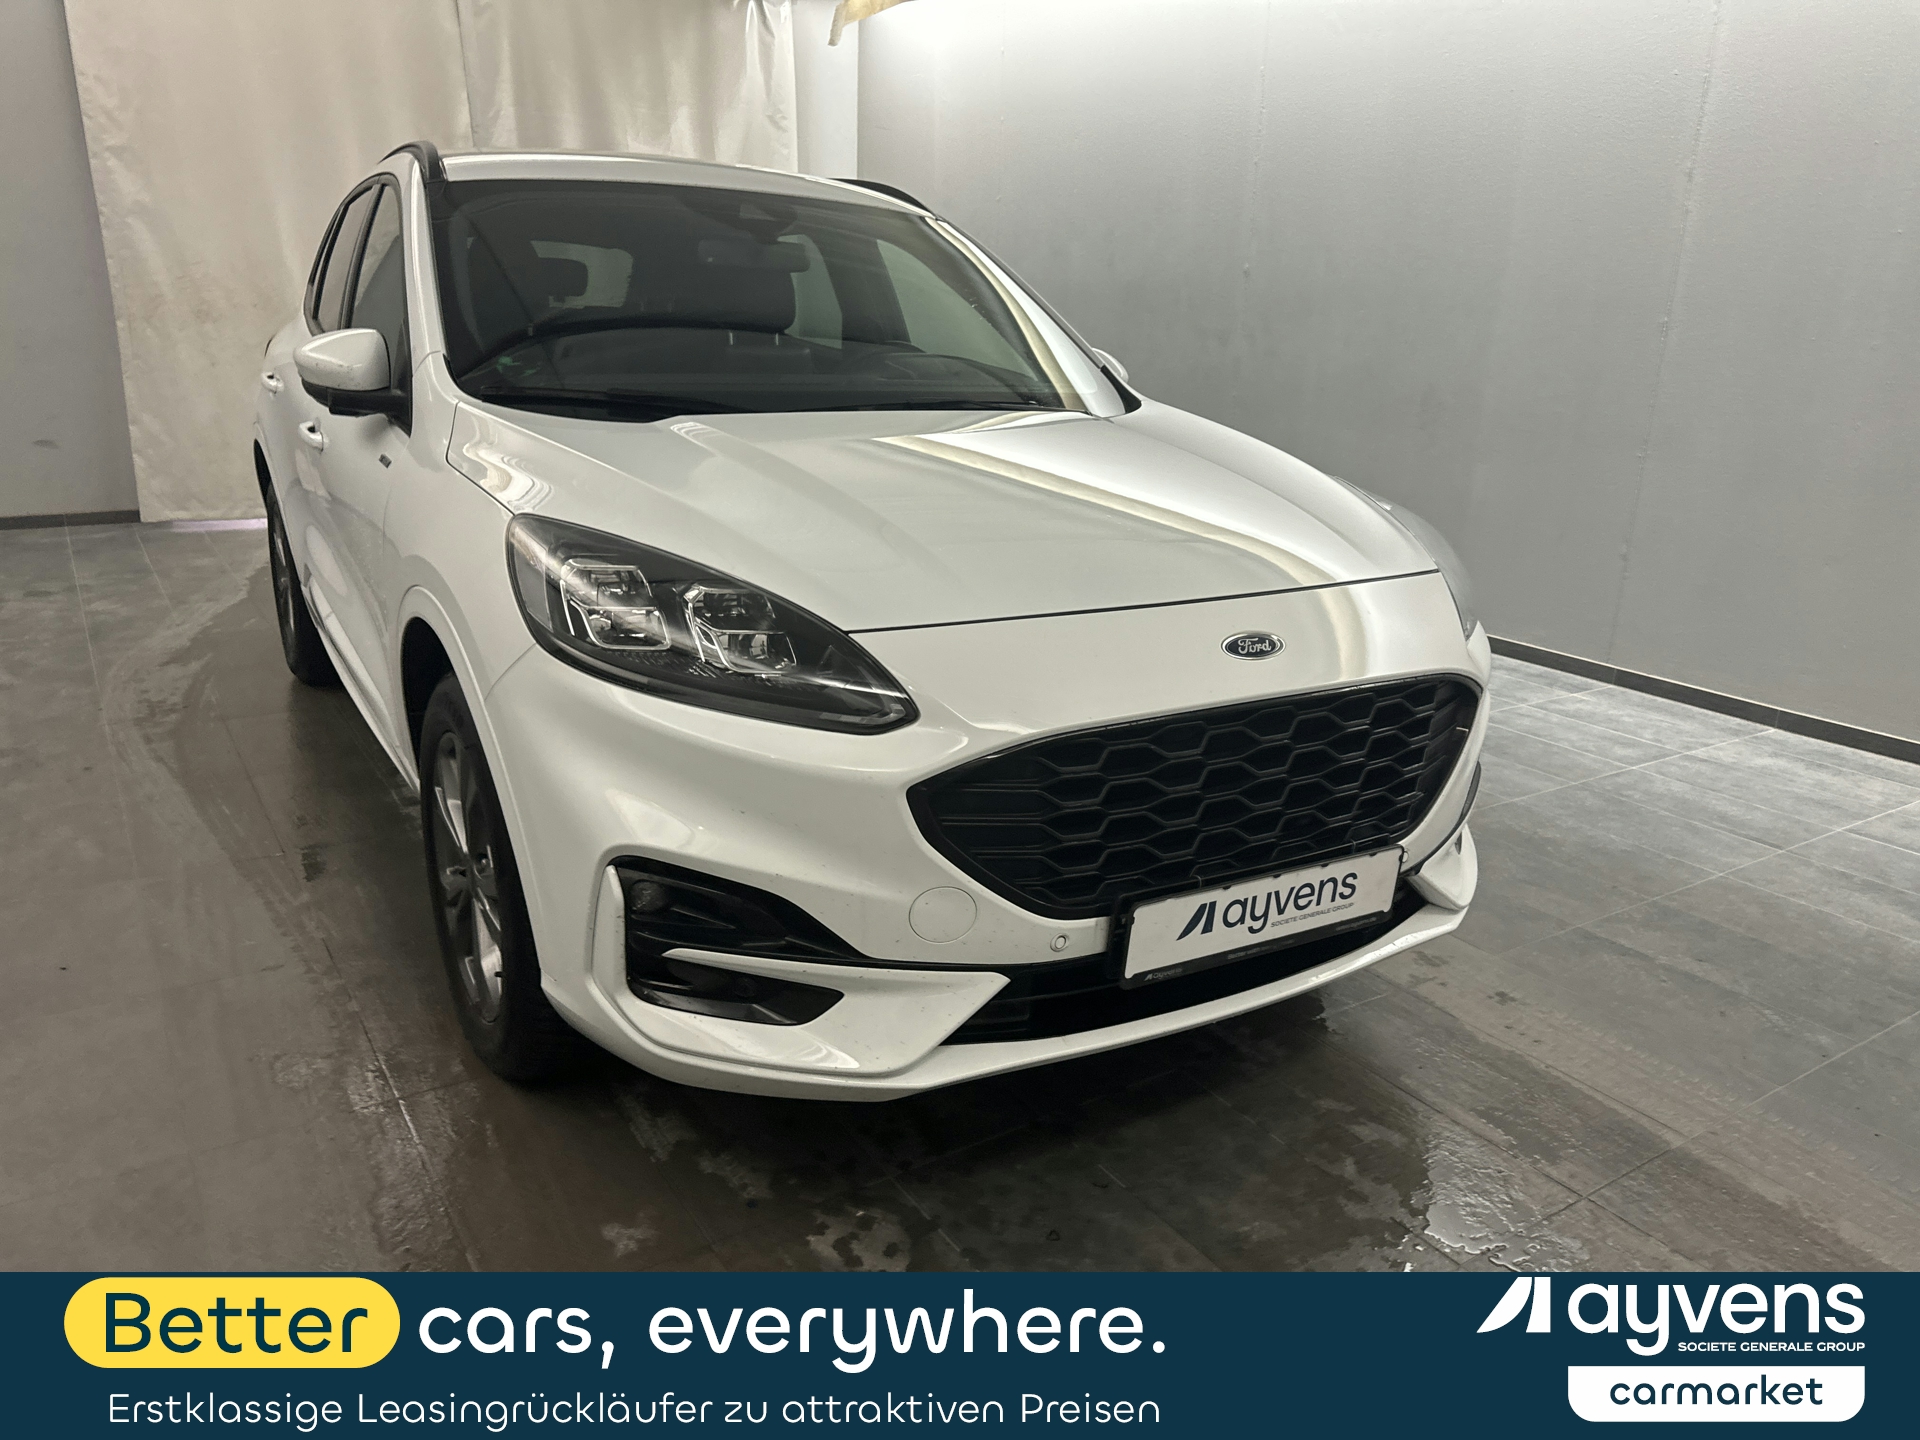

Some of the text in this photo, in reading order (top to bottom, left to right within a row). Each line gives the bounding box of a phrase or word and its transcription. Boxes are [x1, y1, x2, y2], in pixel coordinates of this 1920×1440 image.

[1238, 638, 1272, 654] Ford
[1222, 872, 1358, 934] ayvens
[1271, 902, 1355, 928] SOCIETE GENERALE GROUP
